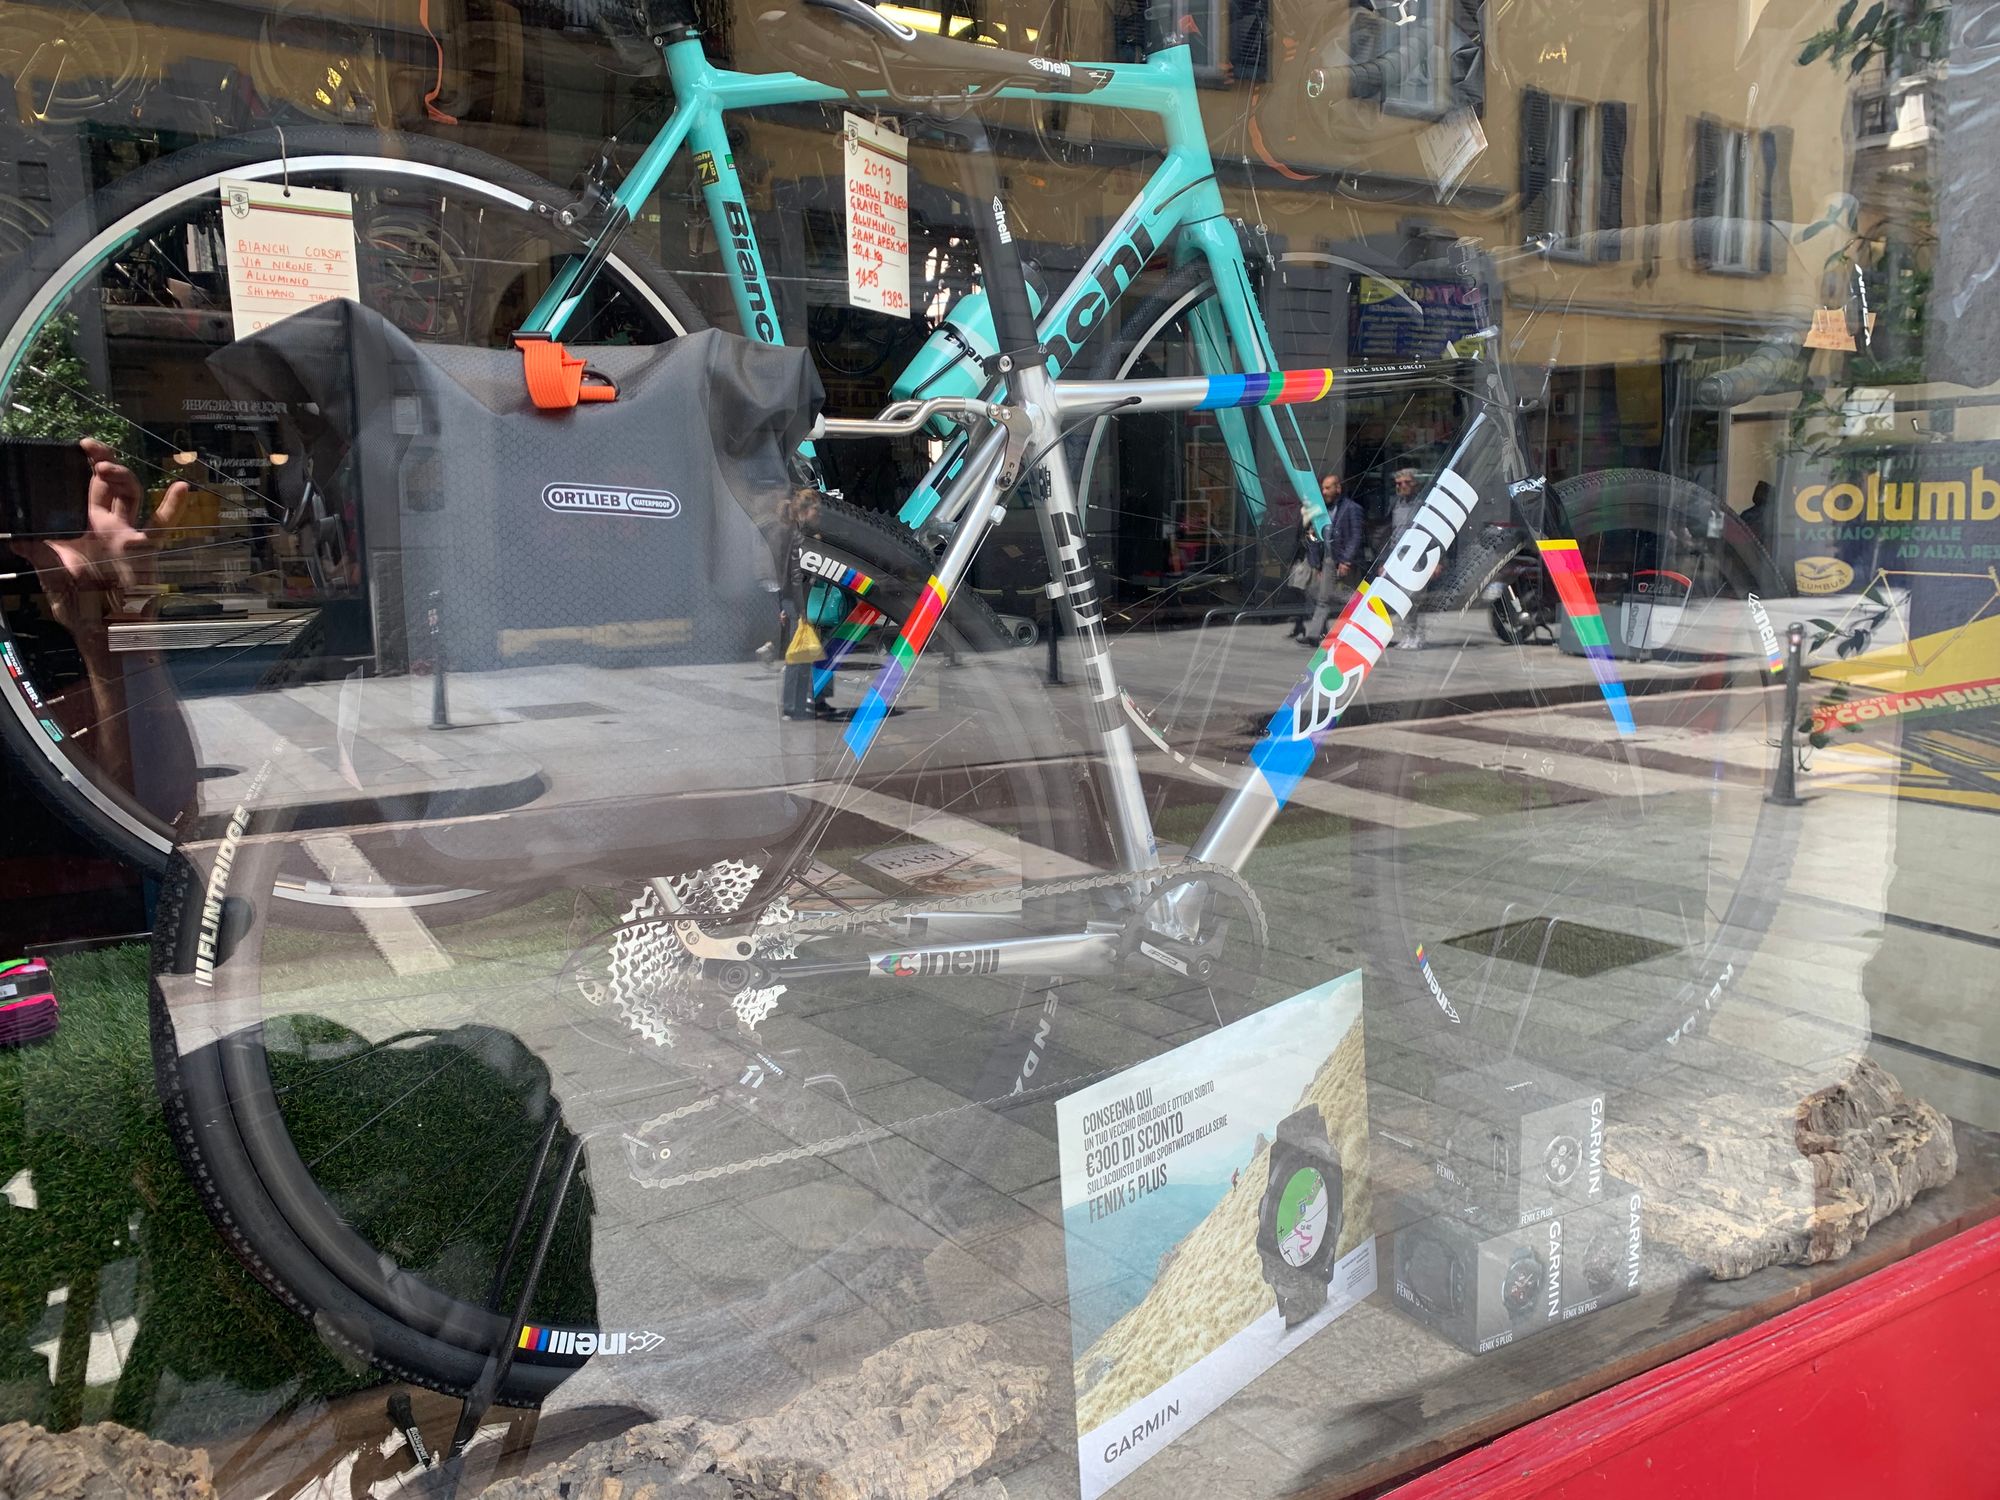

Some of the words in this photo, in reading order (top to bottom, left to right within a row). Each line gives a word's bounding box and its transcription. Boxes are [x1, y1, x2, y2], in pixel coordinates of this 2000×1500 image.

[864, 159, 891, 184] 2019
[850, 180, 881, 201] CINELLI
[850, 196, 885, 218] GRAVEL
[853, 213, 896, 236] ALLUMINIO
[238, 239, 290, 255] BIANCHI
[305, 246, 343, 260] CORSA
[852, 227, 874, 244] SRAM
[878, 235, 895, 249] APEX
[241, 256, 262, 268] VIA
[324, 263, 334, 273] 7
[247, 271, 309, 286] ALLUMINIO
[247, 286, 295, 299] SHIMANO
[551, 489, 621, 509] ORTLIEB
[634, 498, 671, 510] WATERPROOF
[1879, 526, 1962, 541] SPECIALE
[1896, 545, 1919, 559] AD
[1923, 544, 1966, 559] ALTA
[799, 548, 847, 582] elli
[3, 641, 23, 676] Bianchi
[22, 680, 43, 709] ABR-1
[199, 805, 253, 959] FLINTRIDGE
[1083, 1096, 1135, 1135] CONSEGNA
[1136, 1087, 1153, 1111] QUI
[1084, 1136, 1094, 1151] UN
[1095, 1132, 1108, 1145] TUO
[1109, 1117, 1136, 1141] VECCHIO
[1137, 1103, 1166, 1127] OROLOGIO
[1167, 1100, 1172, 1112] E
[1172, 1092, 1194, 1111] OTTIENI
[1195, 1080, 1214, 1100] SUBITO
[1086, 1141, 1119, 1178] €300
[1123, 1135, 1135, 1161] DI
[1138, 1111, 1184, 1153] SCONTO
[1136, 1158, 1142, 1171] DI
[1143, 1153, 1156, 1168] UNO
[1157, 1132, 1195, 1161] SPORTWATCH
[1196, 1123, 1212, 1141] DELLA
[1213, 1114, 1228, 1132] SERIE
[1588, 1098, 1602, 1194] GARMIN
[1089, 1183, 1126, 1224] FENIX
[1129, 1179, 1136, 1204] 5
[1138, 1163, 1167, 1198] PLUS
[1627, 1194, 1641, 1287] GARMIN
[1548, 1221, 1561, 1317] GARMIN
[1500, 1333, 1513, 1346] PLUS
[1103, 1399, 1180, 1465] GARMIN
